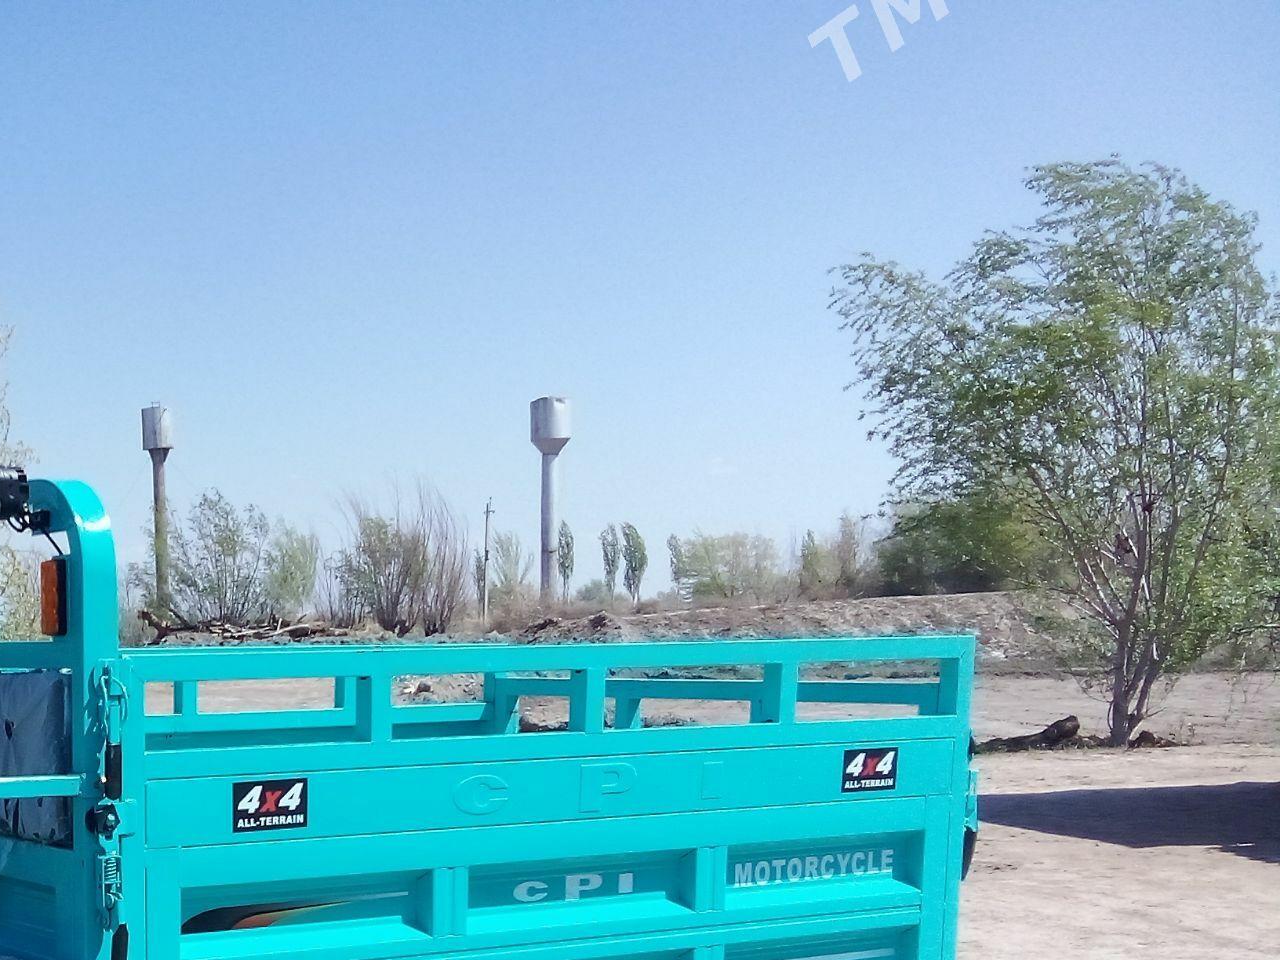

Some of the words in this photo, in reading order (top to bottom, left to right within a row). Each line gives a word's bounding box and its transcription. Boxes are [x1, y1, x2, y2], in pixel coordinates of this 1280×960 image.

[844, 777, 894, 789] ALL-TERRAIN
[236, 813, 304, 829] ALL-TERRAIN
[733, 848, 895, 889] MOTORCYCLE
